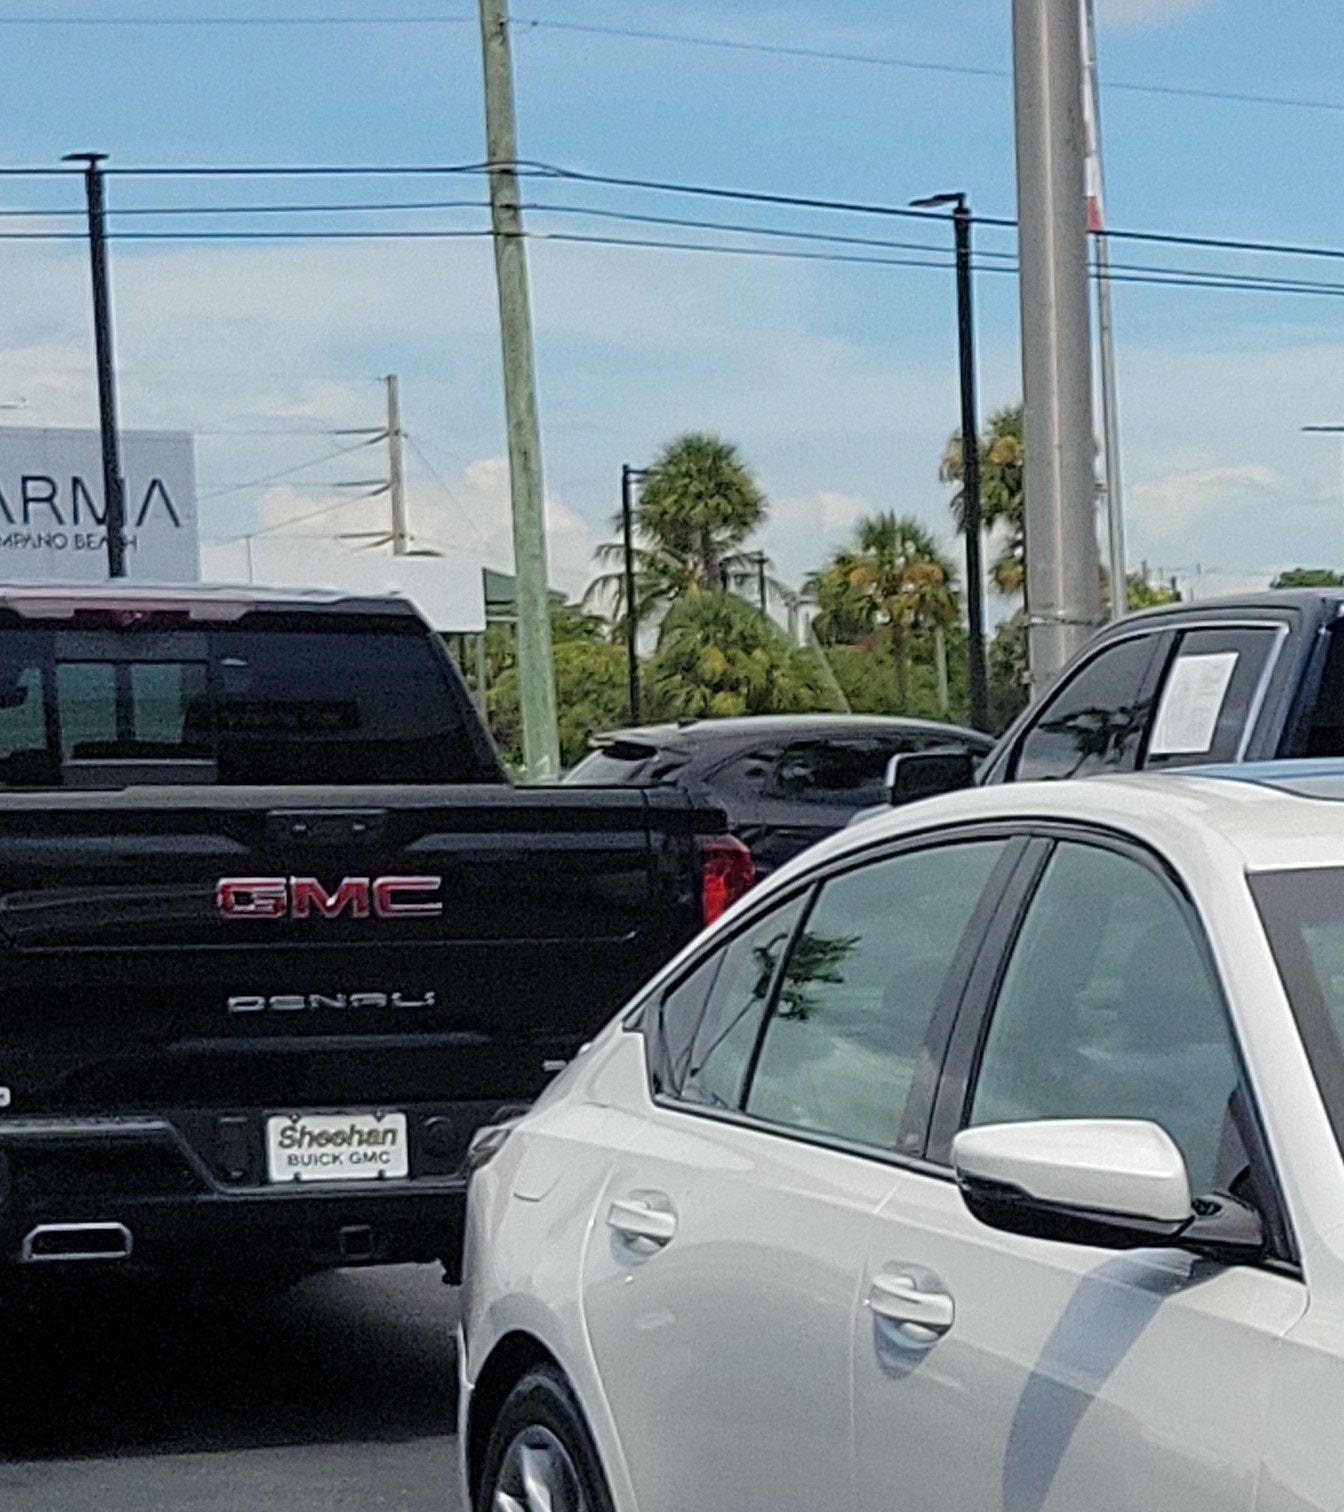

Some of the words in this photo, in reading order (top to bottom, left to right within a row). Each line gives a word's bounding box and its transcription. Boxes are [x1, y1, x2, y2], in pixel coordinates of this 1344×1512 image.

[216, 875, 443, 918] GMC
[227, 992, 436, 1014] DENALI
[288, 1152, 344, 1166] BUICK
[350, 1151, 391, 1164] GMC
